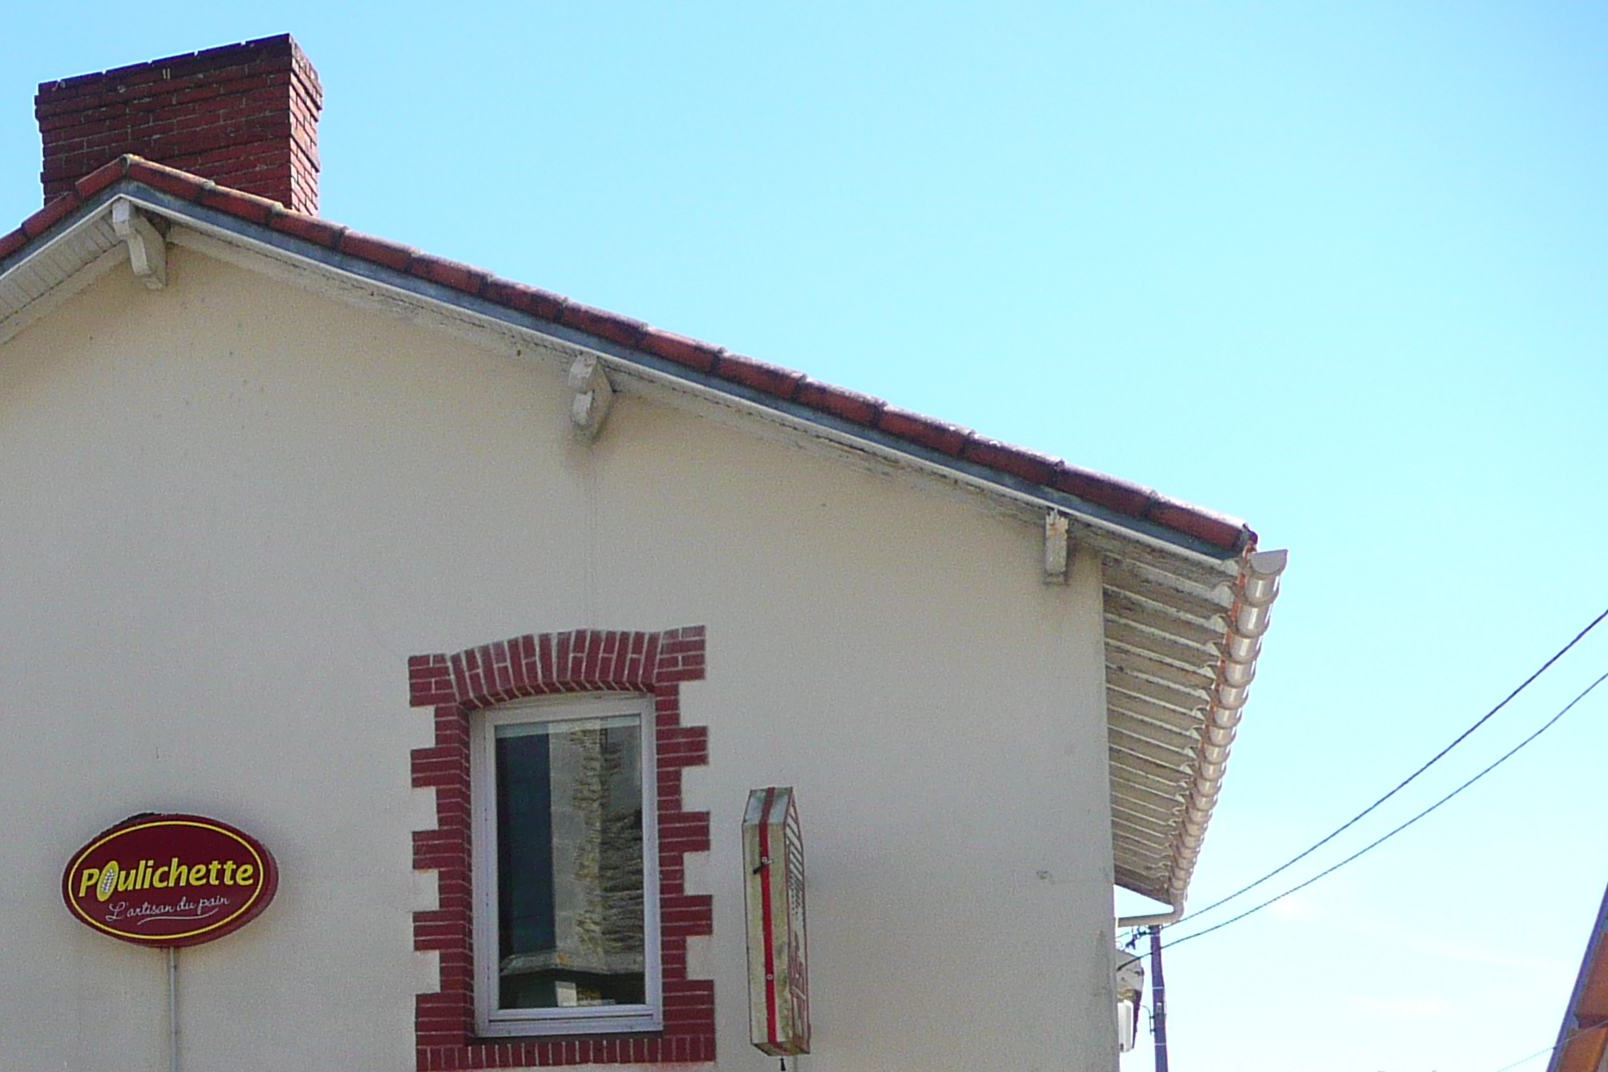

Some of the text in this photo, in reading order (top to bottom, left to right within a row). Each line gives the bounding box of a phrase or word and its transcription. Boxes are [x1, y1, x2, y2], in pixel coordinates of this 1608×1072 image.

[78, 858, 254, 902] Poulichette
[105, 895, 230, 922] L'artisan du pain
